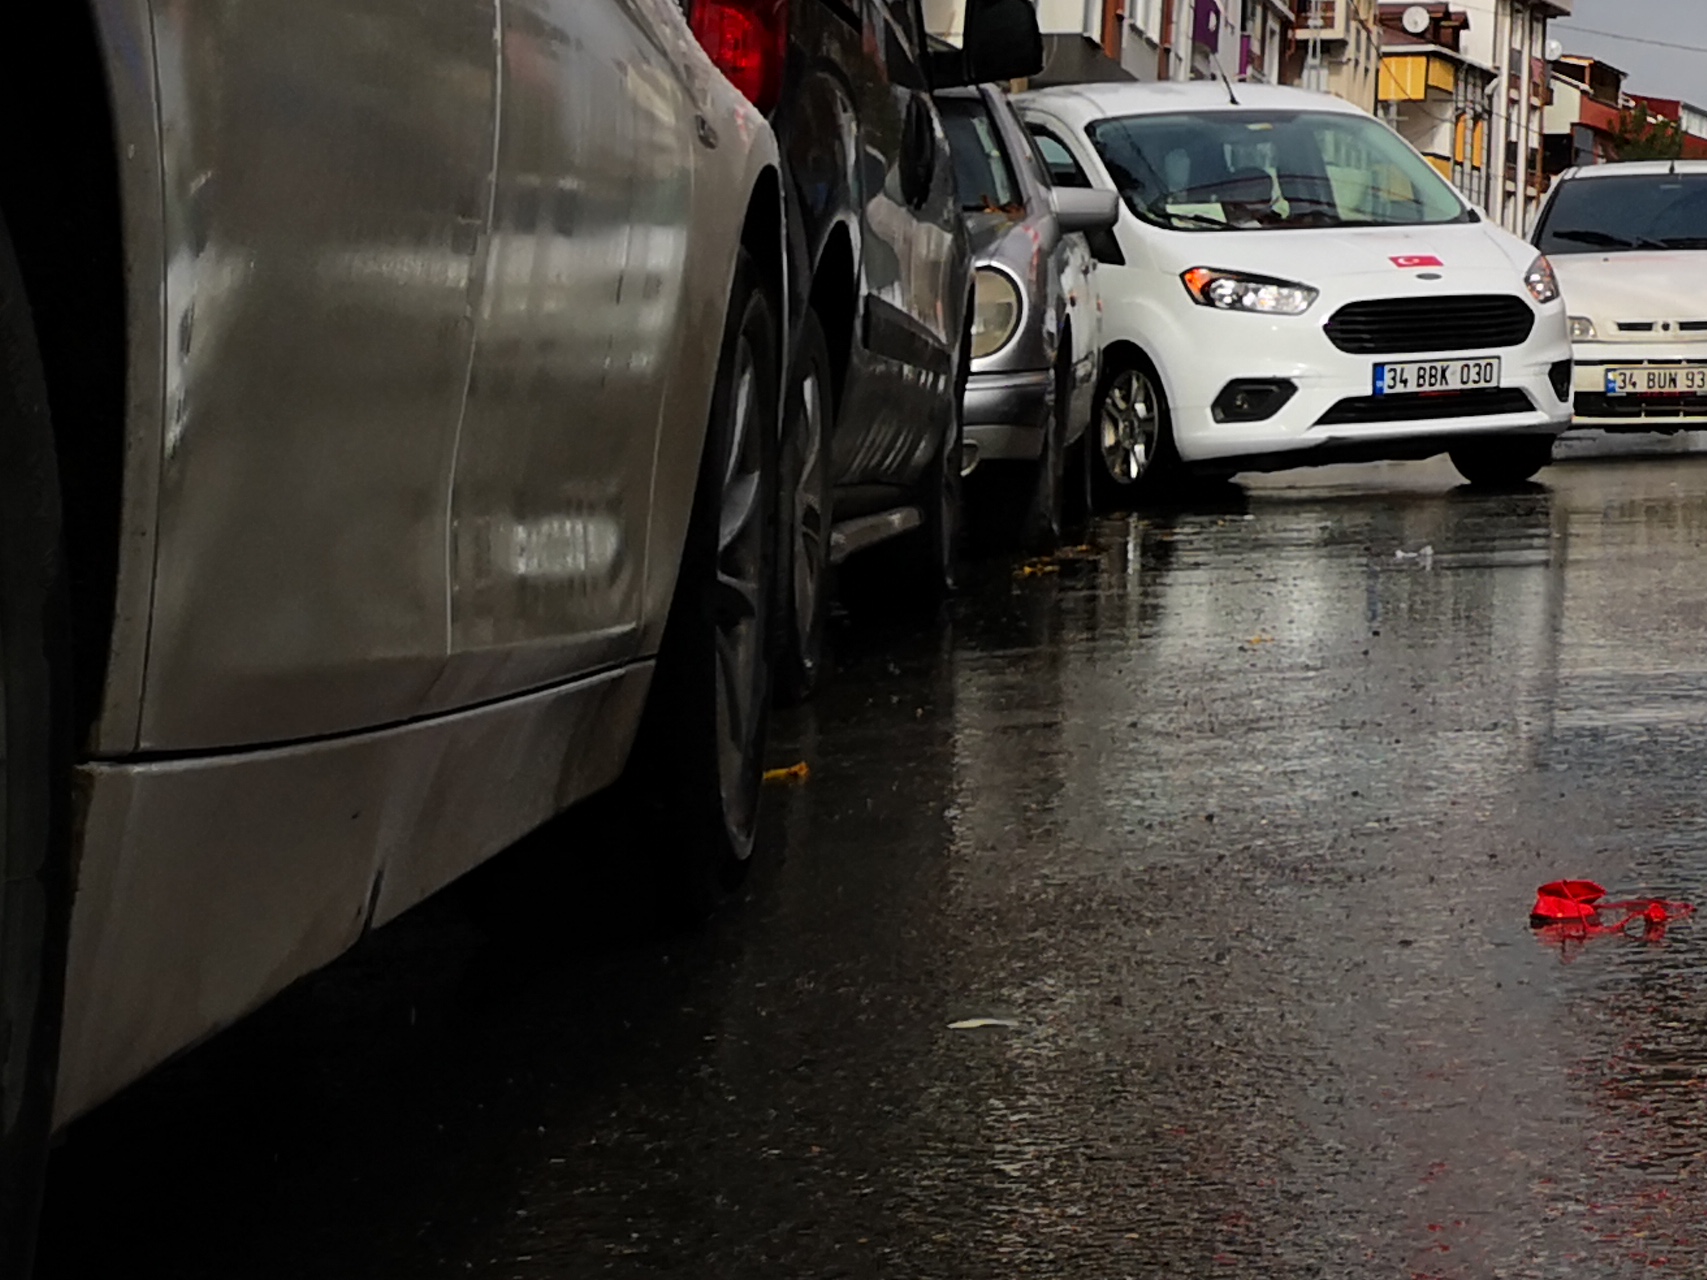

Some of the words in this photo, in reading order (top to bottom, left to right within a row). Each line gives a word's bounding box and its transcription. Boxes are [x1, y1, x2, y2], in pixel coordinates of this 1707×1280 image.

[1387, 368, 1408, 389] 34
[1417, 365, 1450, 388] BBK
[1460, 362, 1493, 385] 030
[1618, 372, 1637, 389] 34
